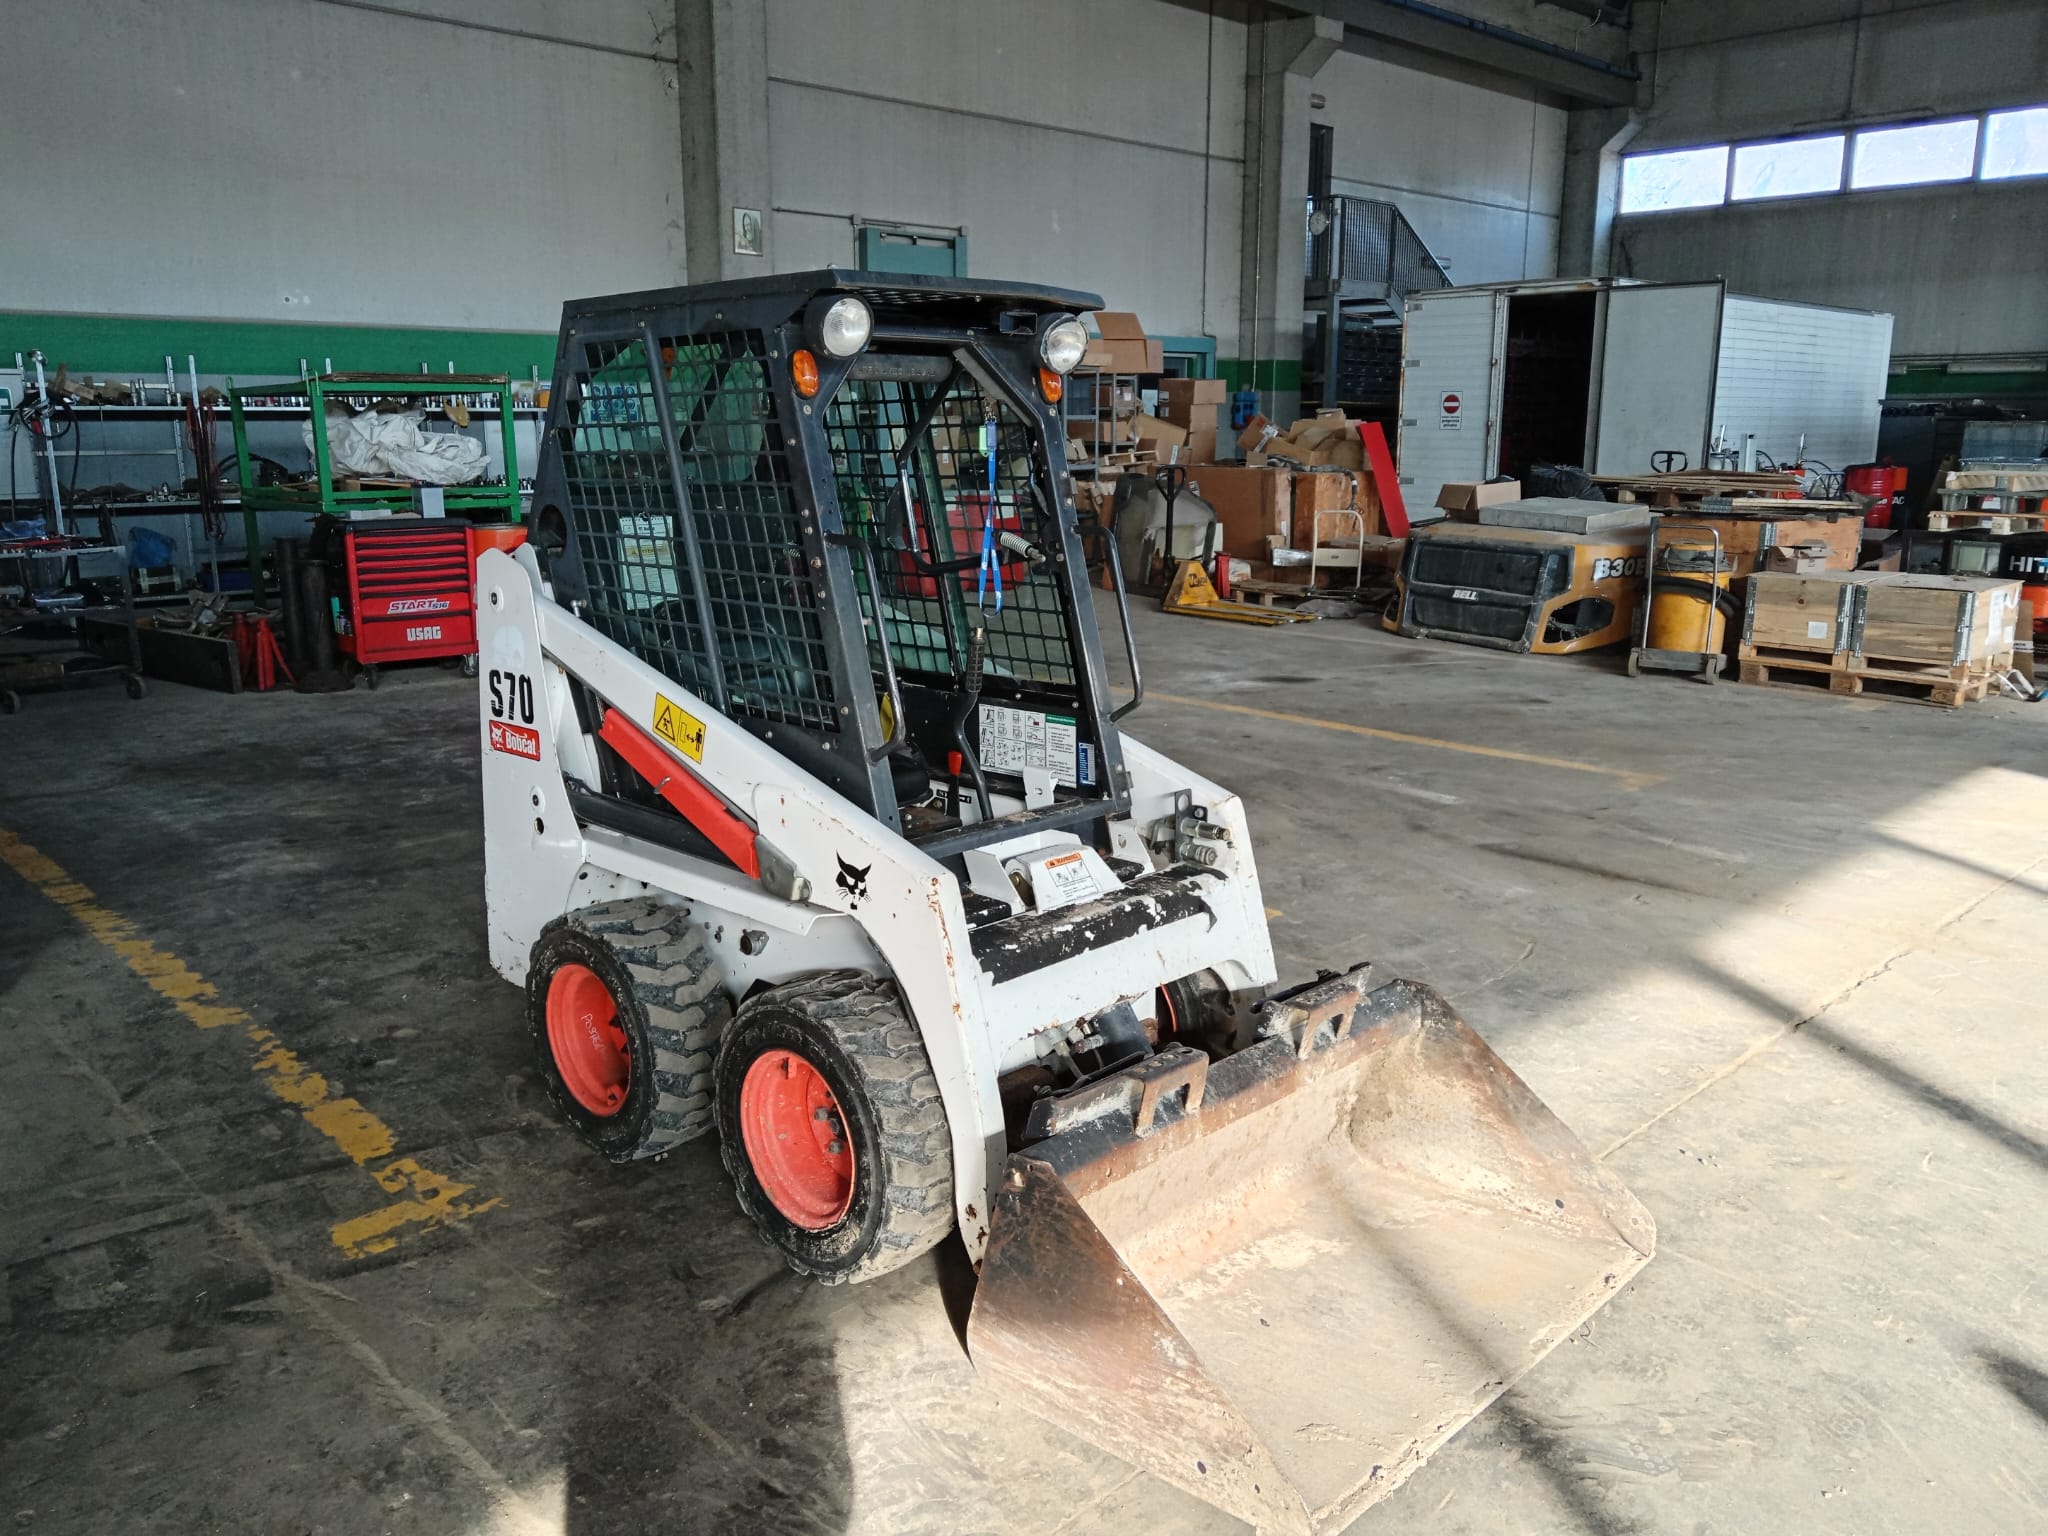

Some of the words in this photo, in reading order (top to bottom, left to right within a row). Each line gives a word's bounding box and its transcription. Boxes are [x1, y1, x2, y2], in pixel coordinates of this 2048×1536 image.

[1452, 589, 1479, 600] BELL
[389, 600, 435, 611] START
[406, 626, 441, 641] USAG
[489, 669, 535, 725] S70
[506, 731, 537, 756] Bobcat
